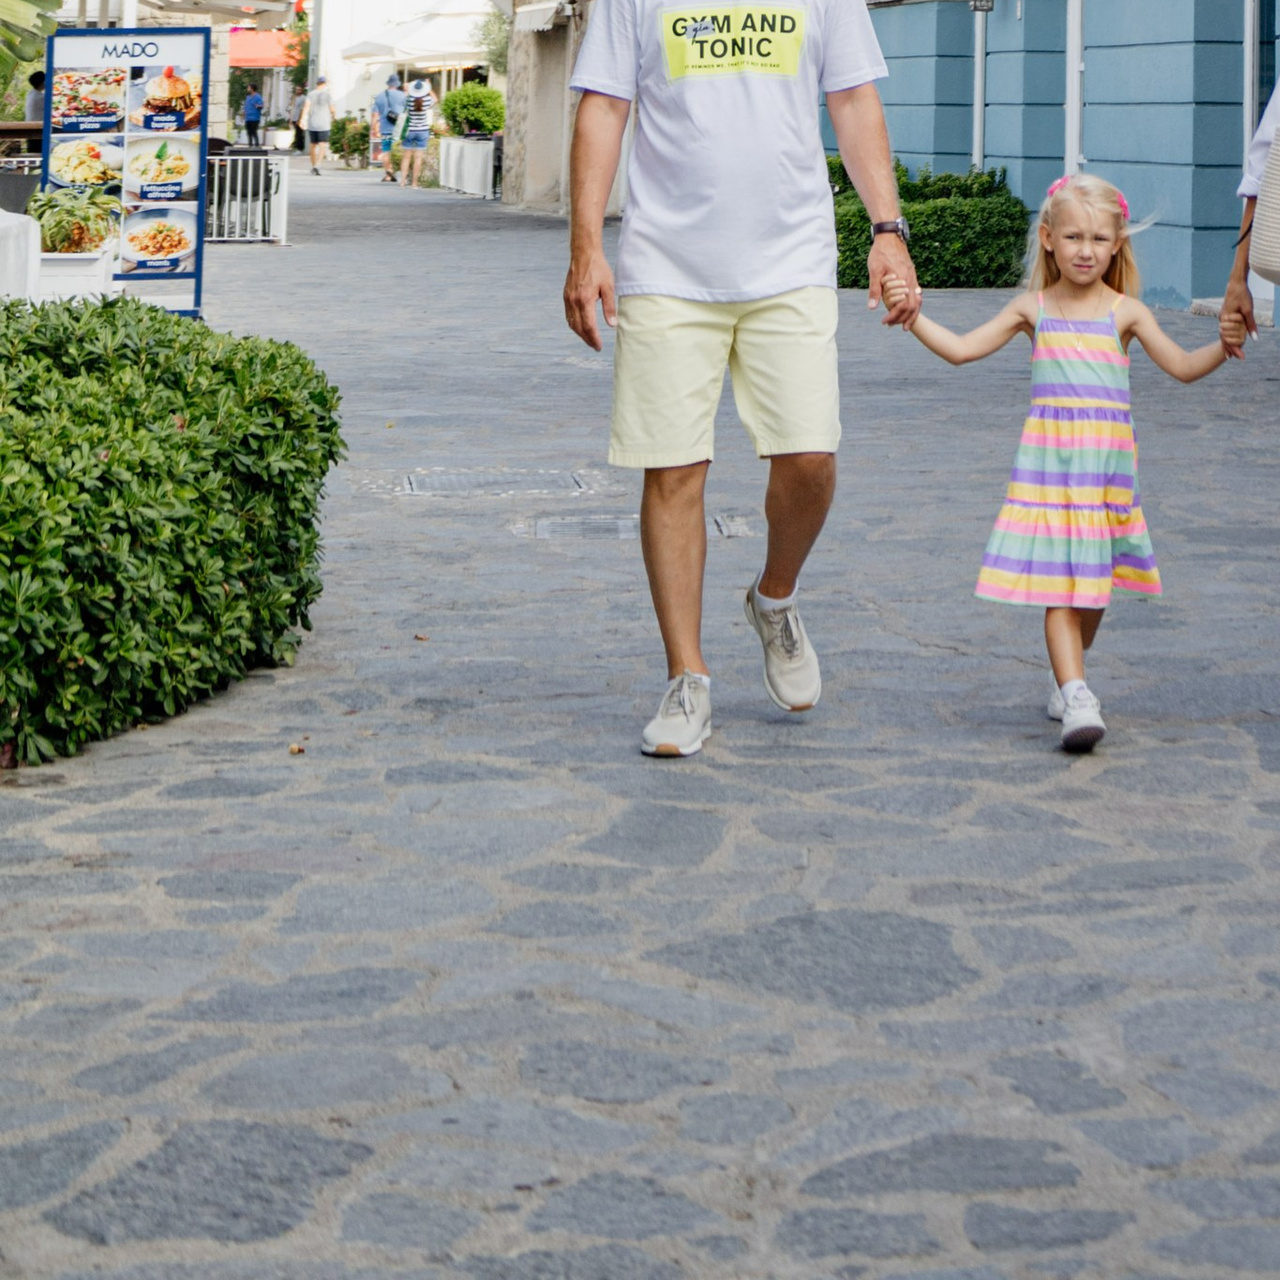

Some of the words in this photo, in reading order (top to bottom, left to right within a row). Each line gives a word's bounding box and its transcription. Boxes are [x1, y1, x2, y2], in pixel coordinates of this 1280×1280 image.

[741, 13, 796, 34] AND
[101, 42, 159, 59] MADO
[695, 37, 773, 59] TONIC
[79, 121, 100, 130] pizza
[151, 121, 178, 130] burger
[142, 184, 181, 192] fettuccine
[147, 191, 176, 199] alfredo
